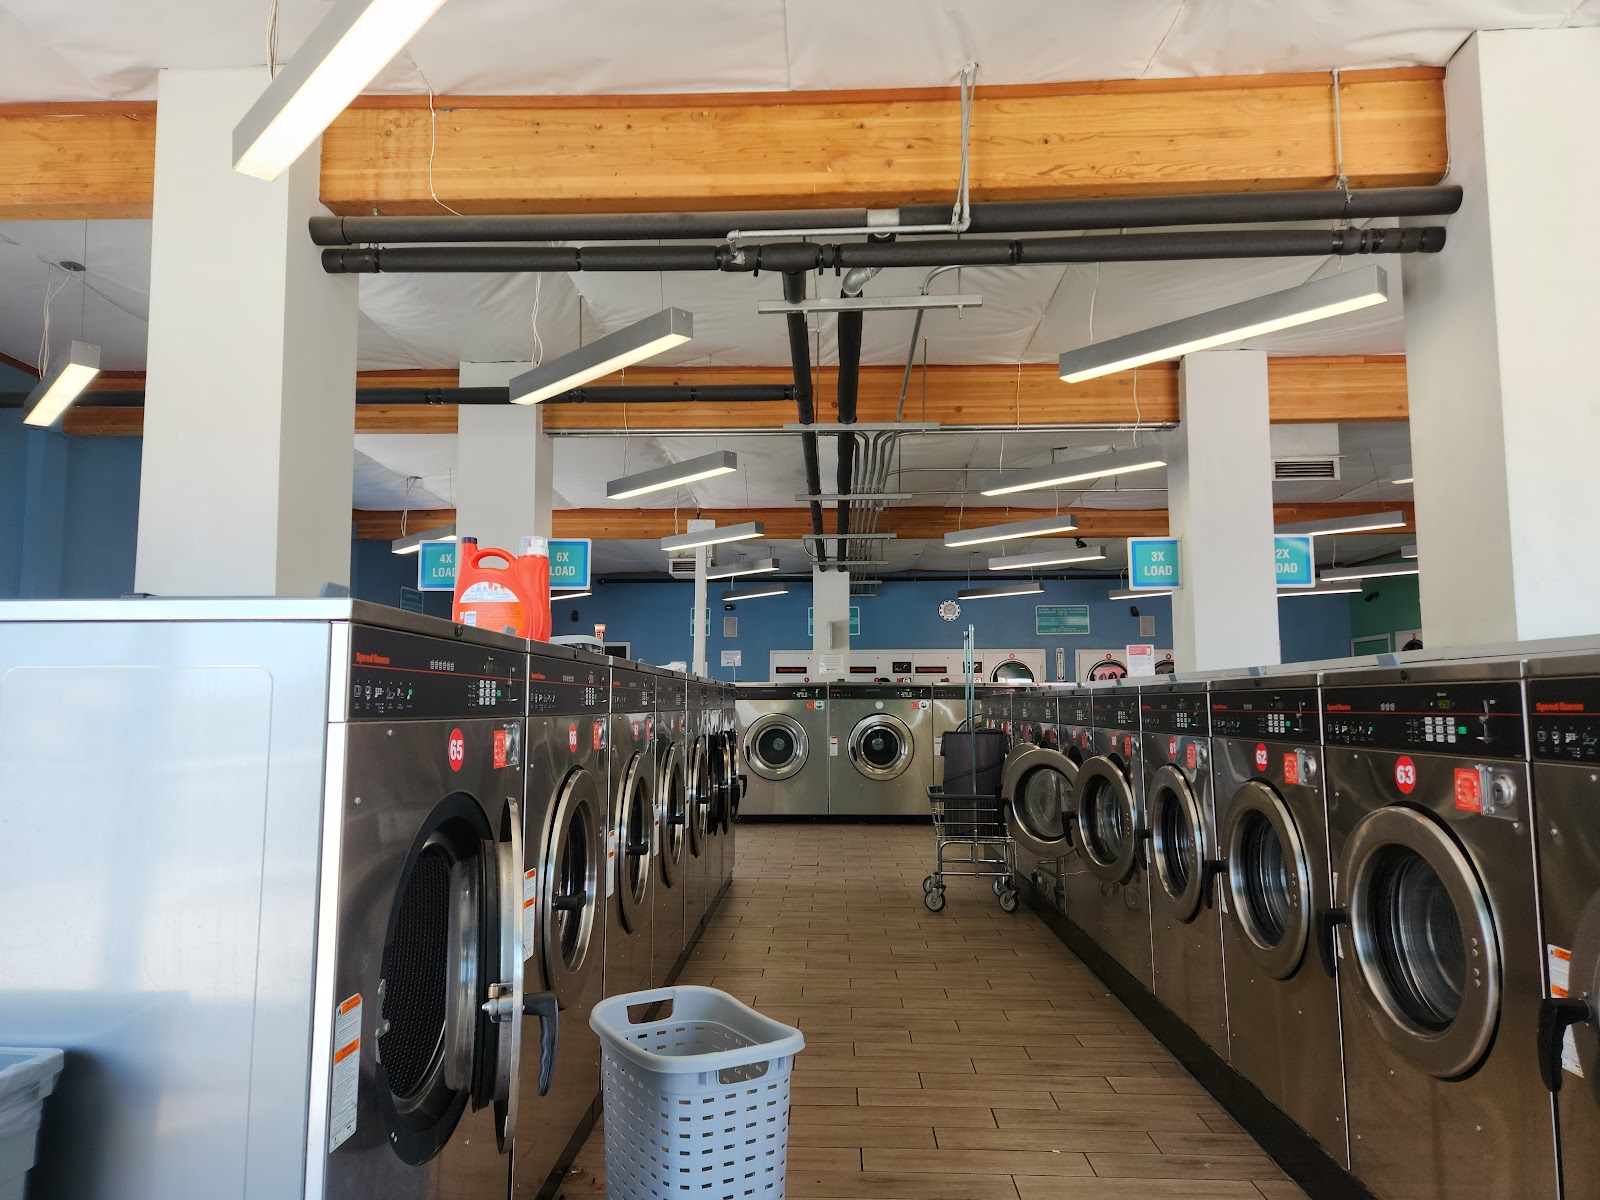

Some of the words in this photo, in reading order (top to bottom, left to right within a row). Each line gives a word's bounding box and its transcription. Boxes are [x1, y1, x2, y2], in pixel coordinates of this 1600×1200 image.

[439, 553, 452, 564] 4X
[556, 552, 569, 562] 6X
[1151, 551, 1165, 562] 3X
[1276, 548, 1290, 559] 2X
[549, 565, 575, 576] LOAD
[1143, 565, 1173, 576] LOAD
[1276, 562, 1298, 574] OAD
[569, 730, 577, 746] 66
[450, 739, 463, 761] 65
[1169, 742, 1176, 755] 61
[1256, 750, 1267, 765] 62
[1396, 765, 1414, 785] 63
